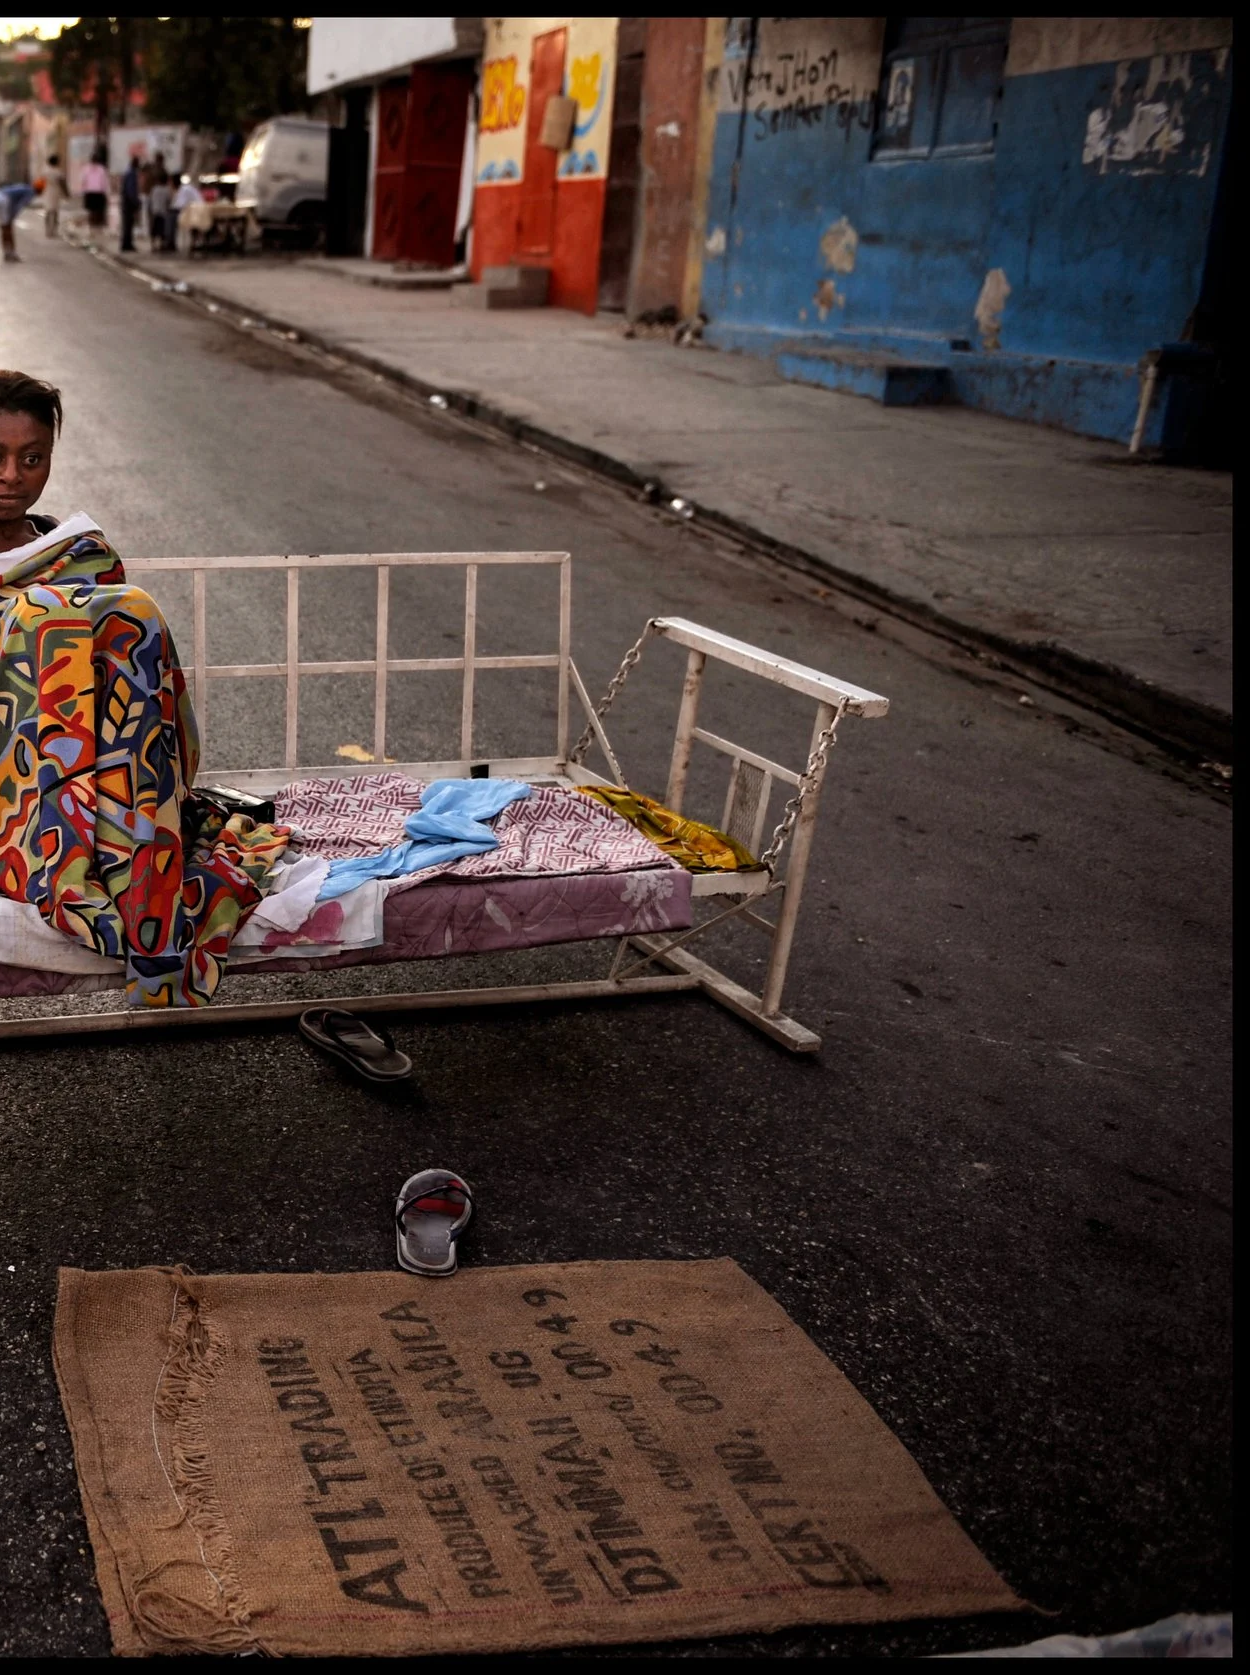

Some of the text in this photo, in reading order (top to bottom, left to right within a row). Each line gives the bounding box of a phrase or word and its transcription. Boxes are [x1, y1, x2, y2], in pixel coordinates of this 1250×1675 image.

[257, 1336, 368, 1496] TRADING
[347, 1347, 512, 1600] PRODUCE OF ETHIOPIA
[379, 1300, 584, 1607] UNWASHED ARABICA
